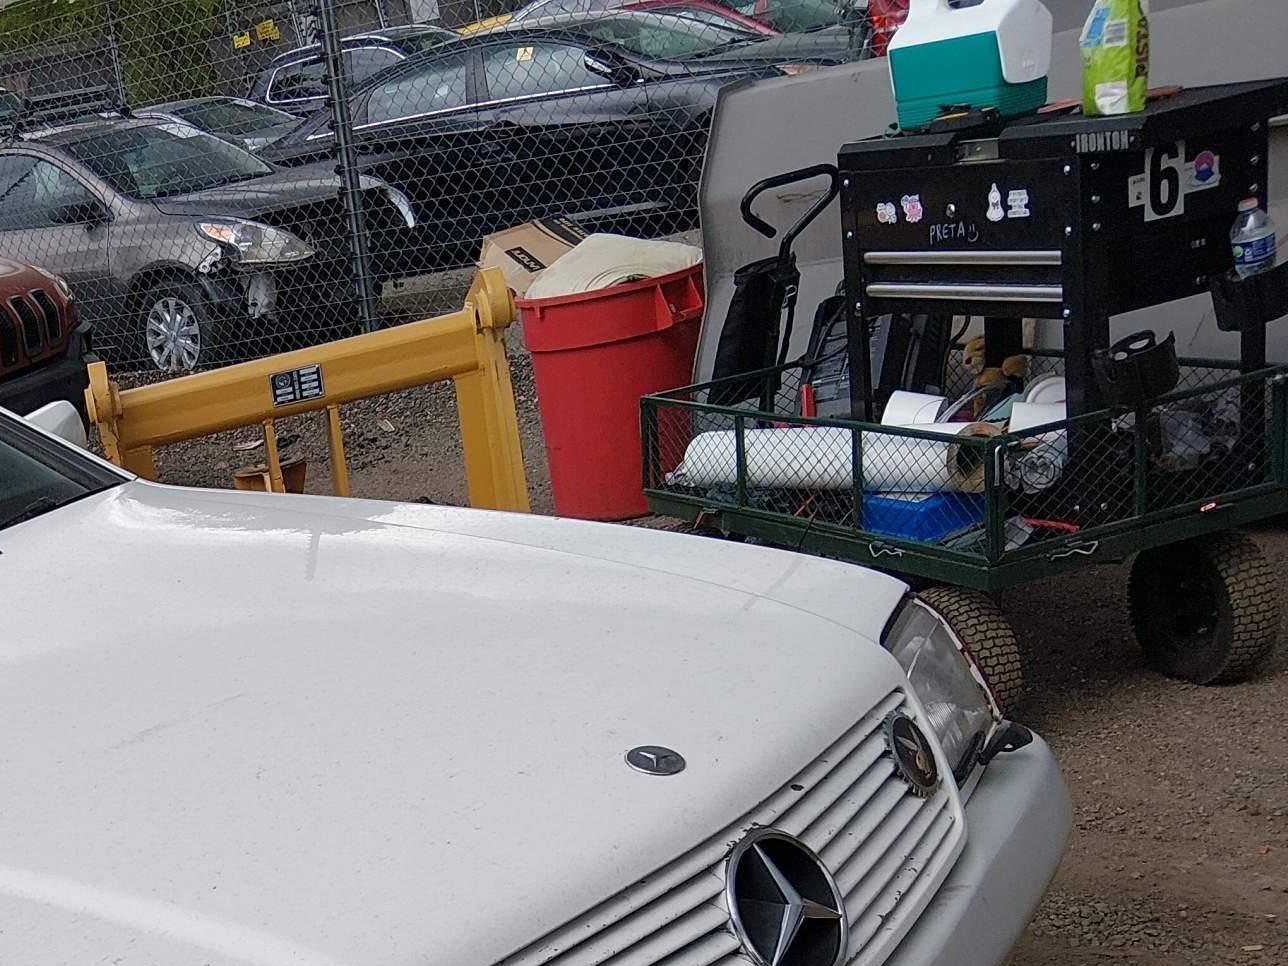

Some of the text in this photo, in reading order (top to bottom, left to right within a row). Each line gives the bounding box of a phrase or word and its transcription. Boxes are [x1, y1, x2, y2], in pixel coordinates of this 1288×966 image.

[1076, 130, 1129, 153] IRONTON
[1150, 142, 1180, 217] 6
[929, 222, 966, 245] PRETA
